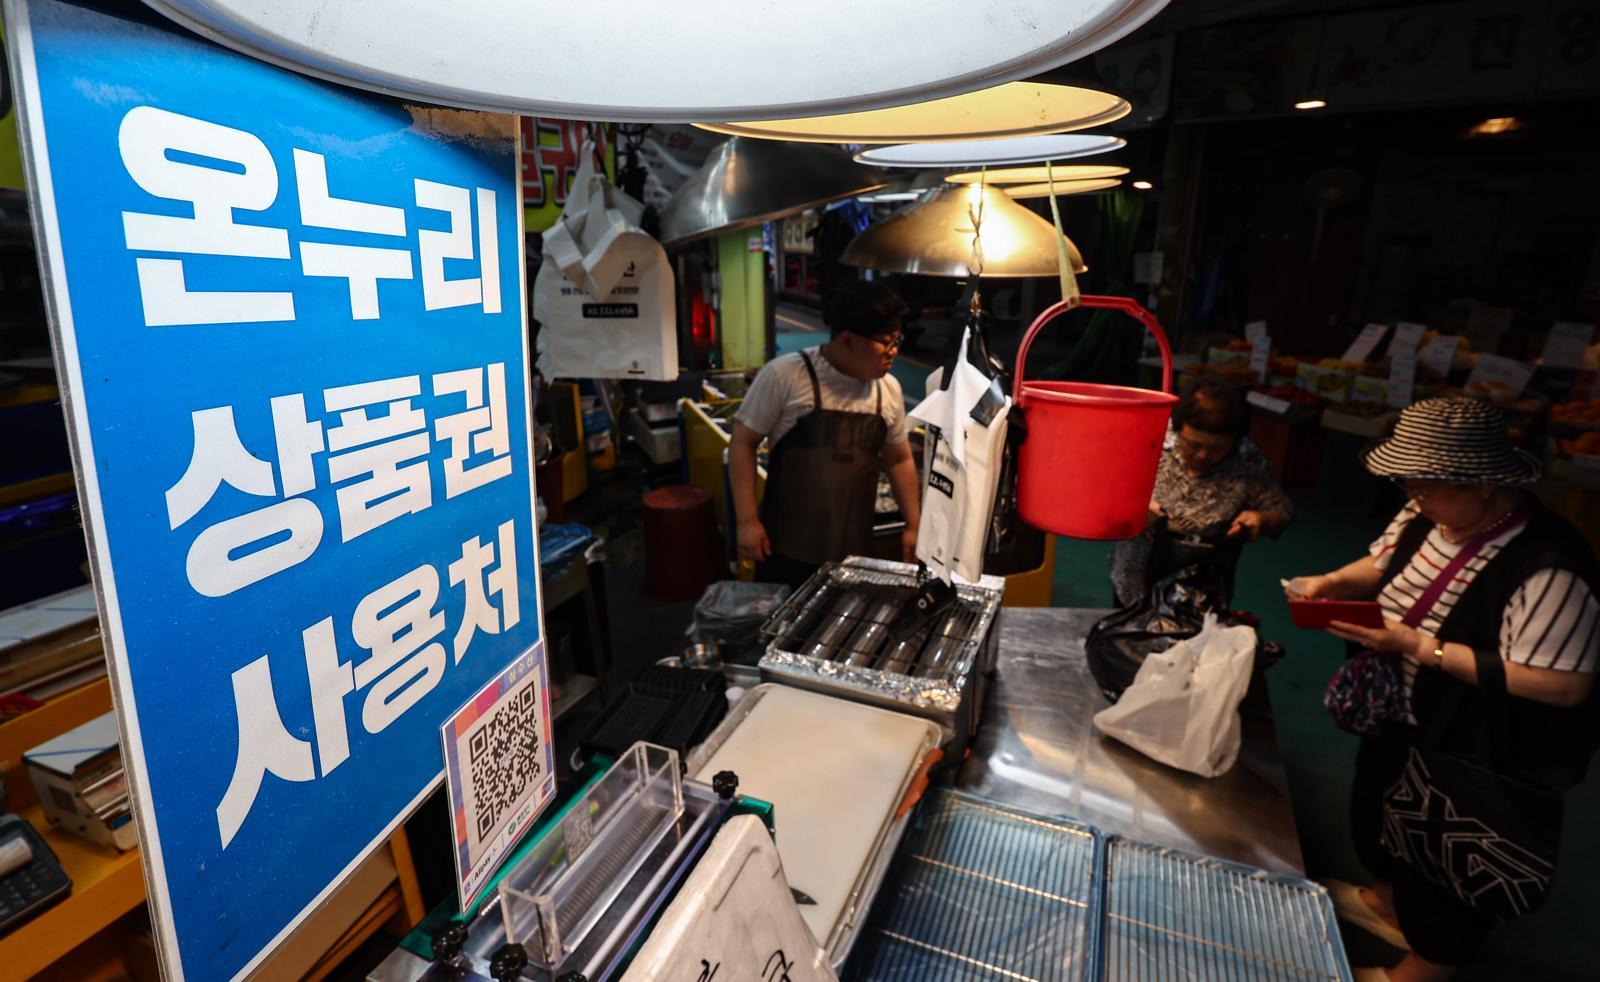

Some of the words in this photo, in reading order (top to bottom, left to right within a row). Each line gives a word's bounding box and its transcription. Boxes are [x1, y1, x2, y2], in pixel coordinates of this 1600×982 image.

[119, 106, 502, 327] 온누리
[166, 363, 513, 597] 상품권
[217, 519, 521, 850] 사용처
